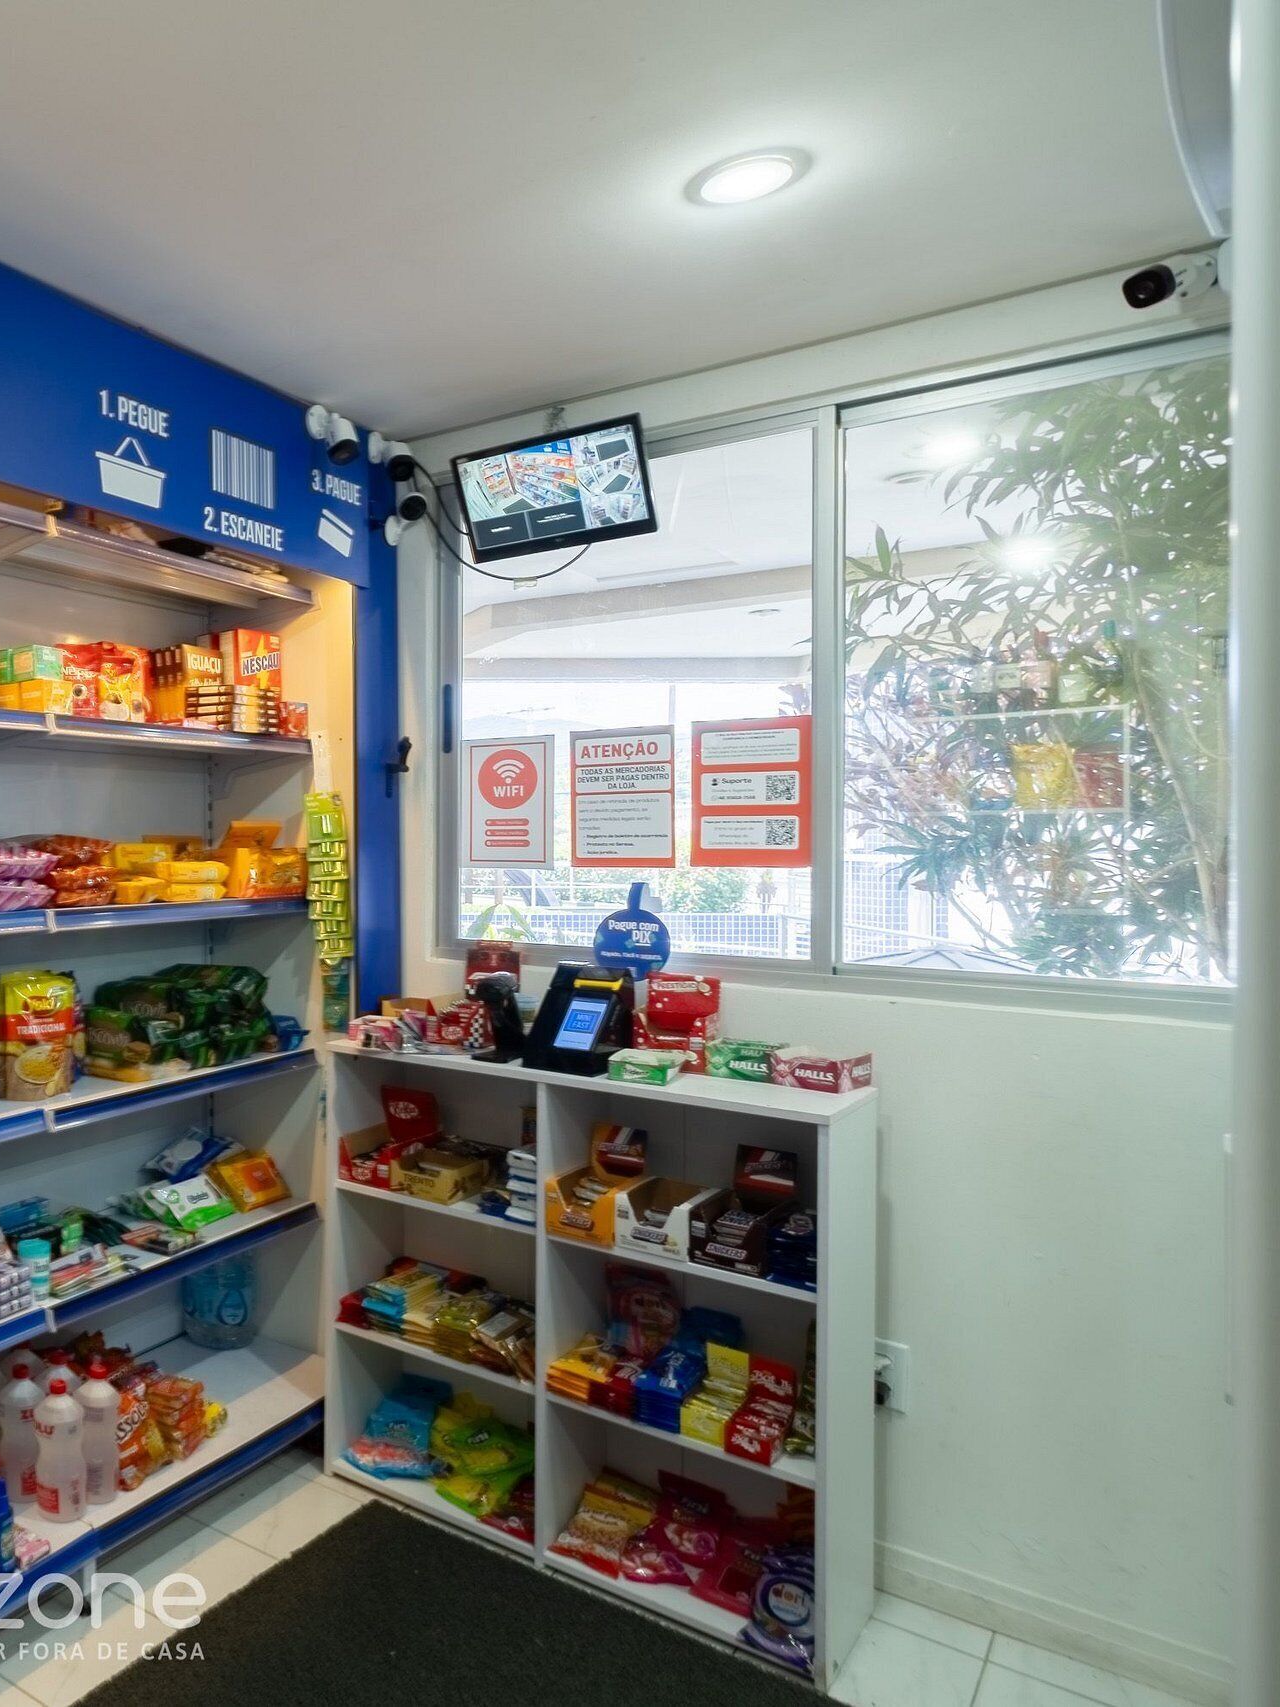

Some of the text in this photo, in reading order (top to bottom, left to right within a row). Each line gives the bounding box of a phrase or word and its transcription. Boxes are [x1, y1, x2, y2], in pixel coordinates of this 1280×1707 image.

[99, 389, 169, 438] 1. PEGUE
[325, 473, 362, 506] PAGUE
[204, 506, 284, 552] 2. ESCANEIE
[242, 651, 280, 677] NESCAU
[580, 740, 658, 760] ATENÇÃO
[581, 768, 603, 776] TODAS
[615, 765, 665, 774] MERCADORIAS
[577, 775, 599, 784] DEVEM
[641, 773, 669, 781] DENTRO
[493, 785, 524, 798] WIFI
[608, 919, 659, 932] Pague com
[632, 929, 651, 944] PIX
[729, 1060, 769, 1074] HALLS
[794, 1068, 836, 1083] HALLS
